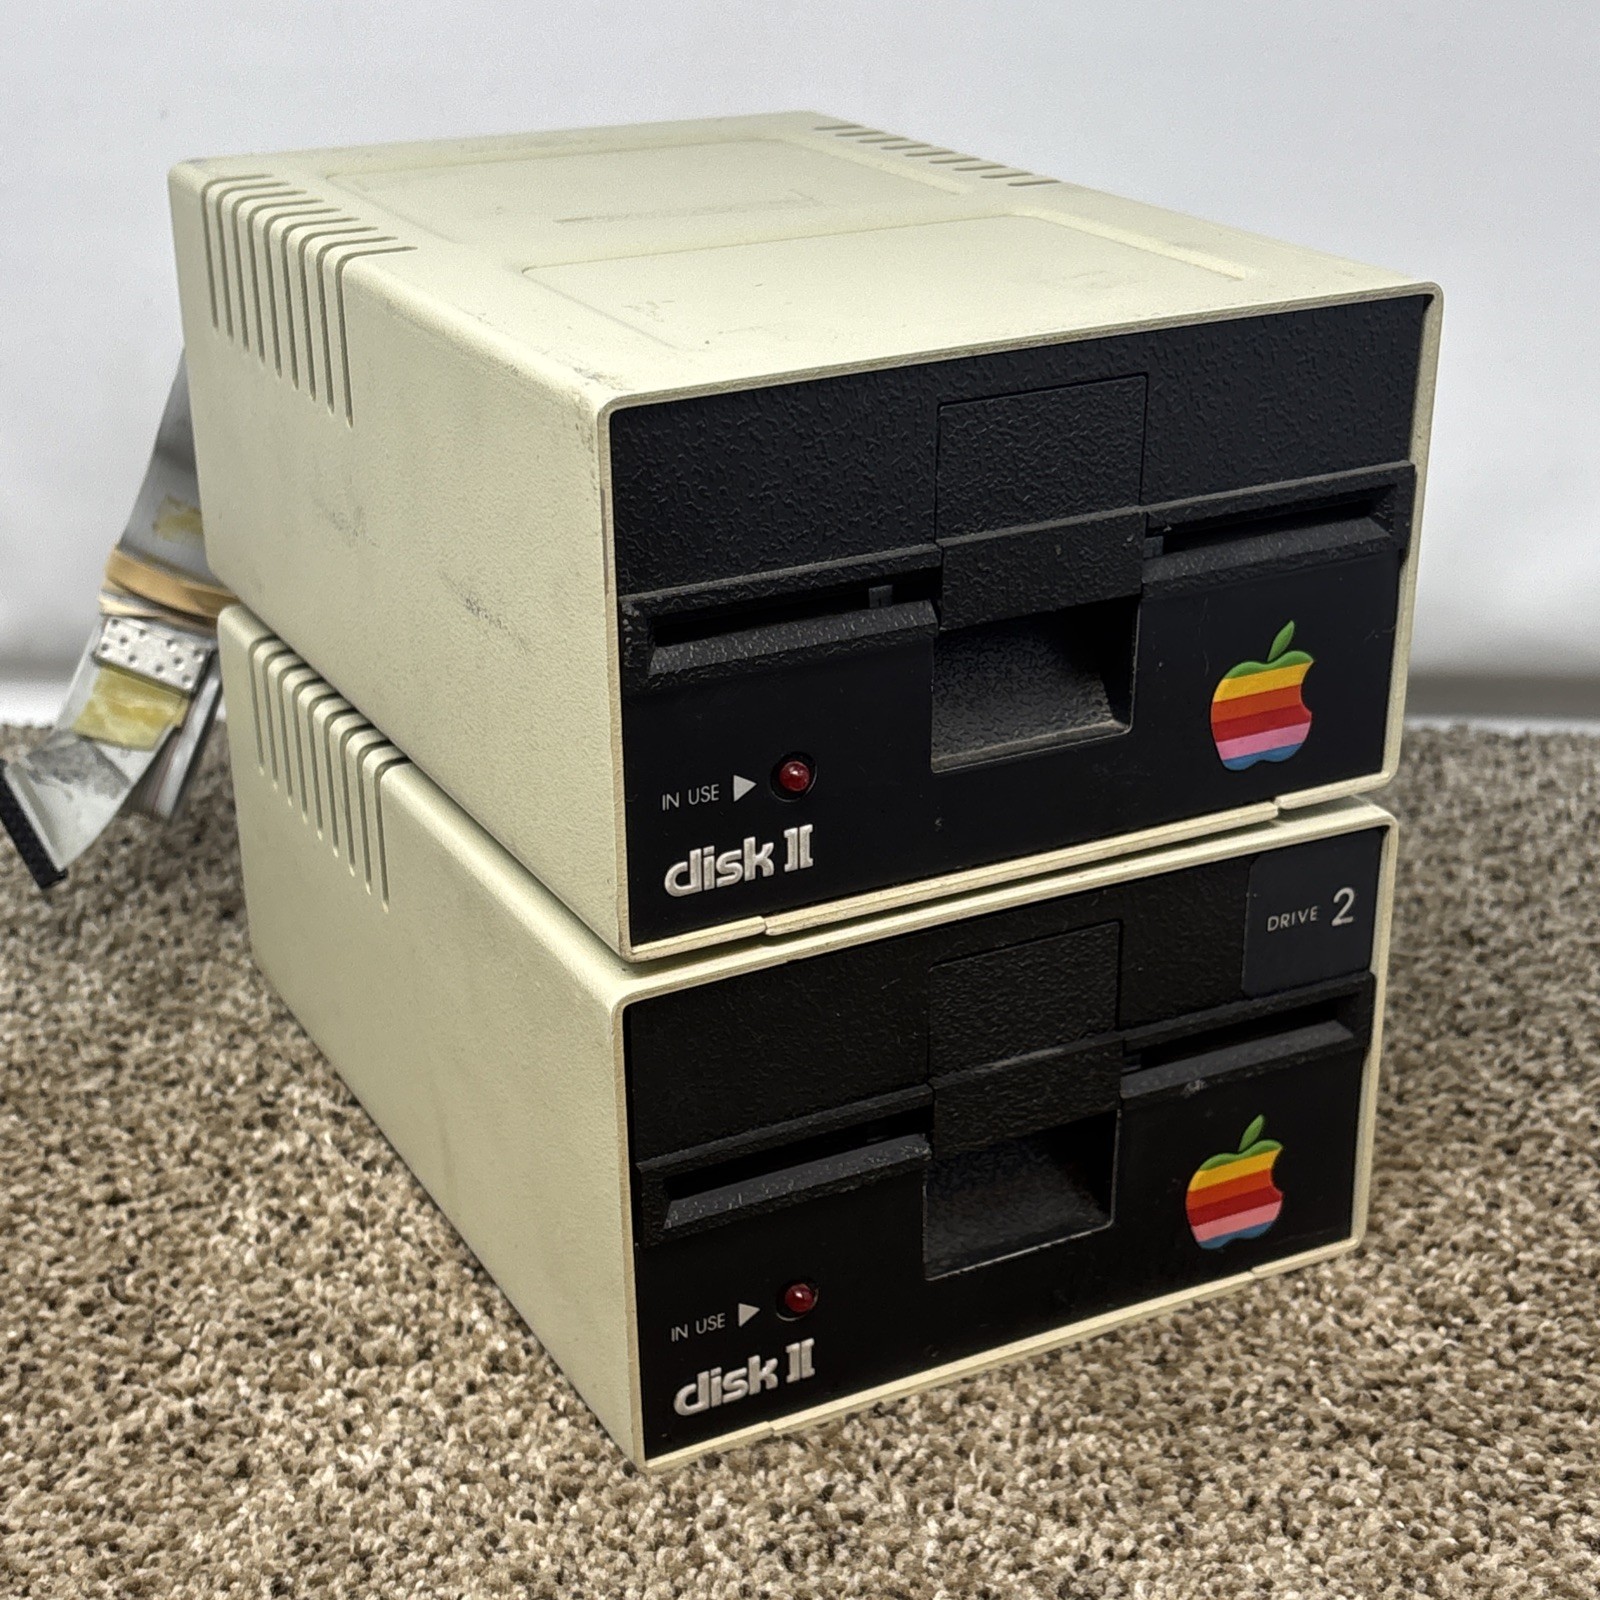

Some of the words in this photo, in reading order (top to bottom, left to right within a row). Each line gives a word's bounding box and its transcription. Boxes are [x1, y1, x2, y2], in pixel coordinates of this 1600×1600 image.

[662, 792, 680, 811] IN
[688, 784, 720, 805] USE
[664, 836, 775, 897] disk
[1267, 905, 1319, 932] DRIVE
[1331, 887, 1355, 927] 2
[671, 1323, 689, 1342] IN
[695, 1313, 726, 1335] USE
[673, 1354, 778, 1416] disk
